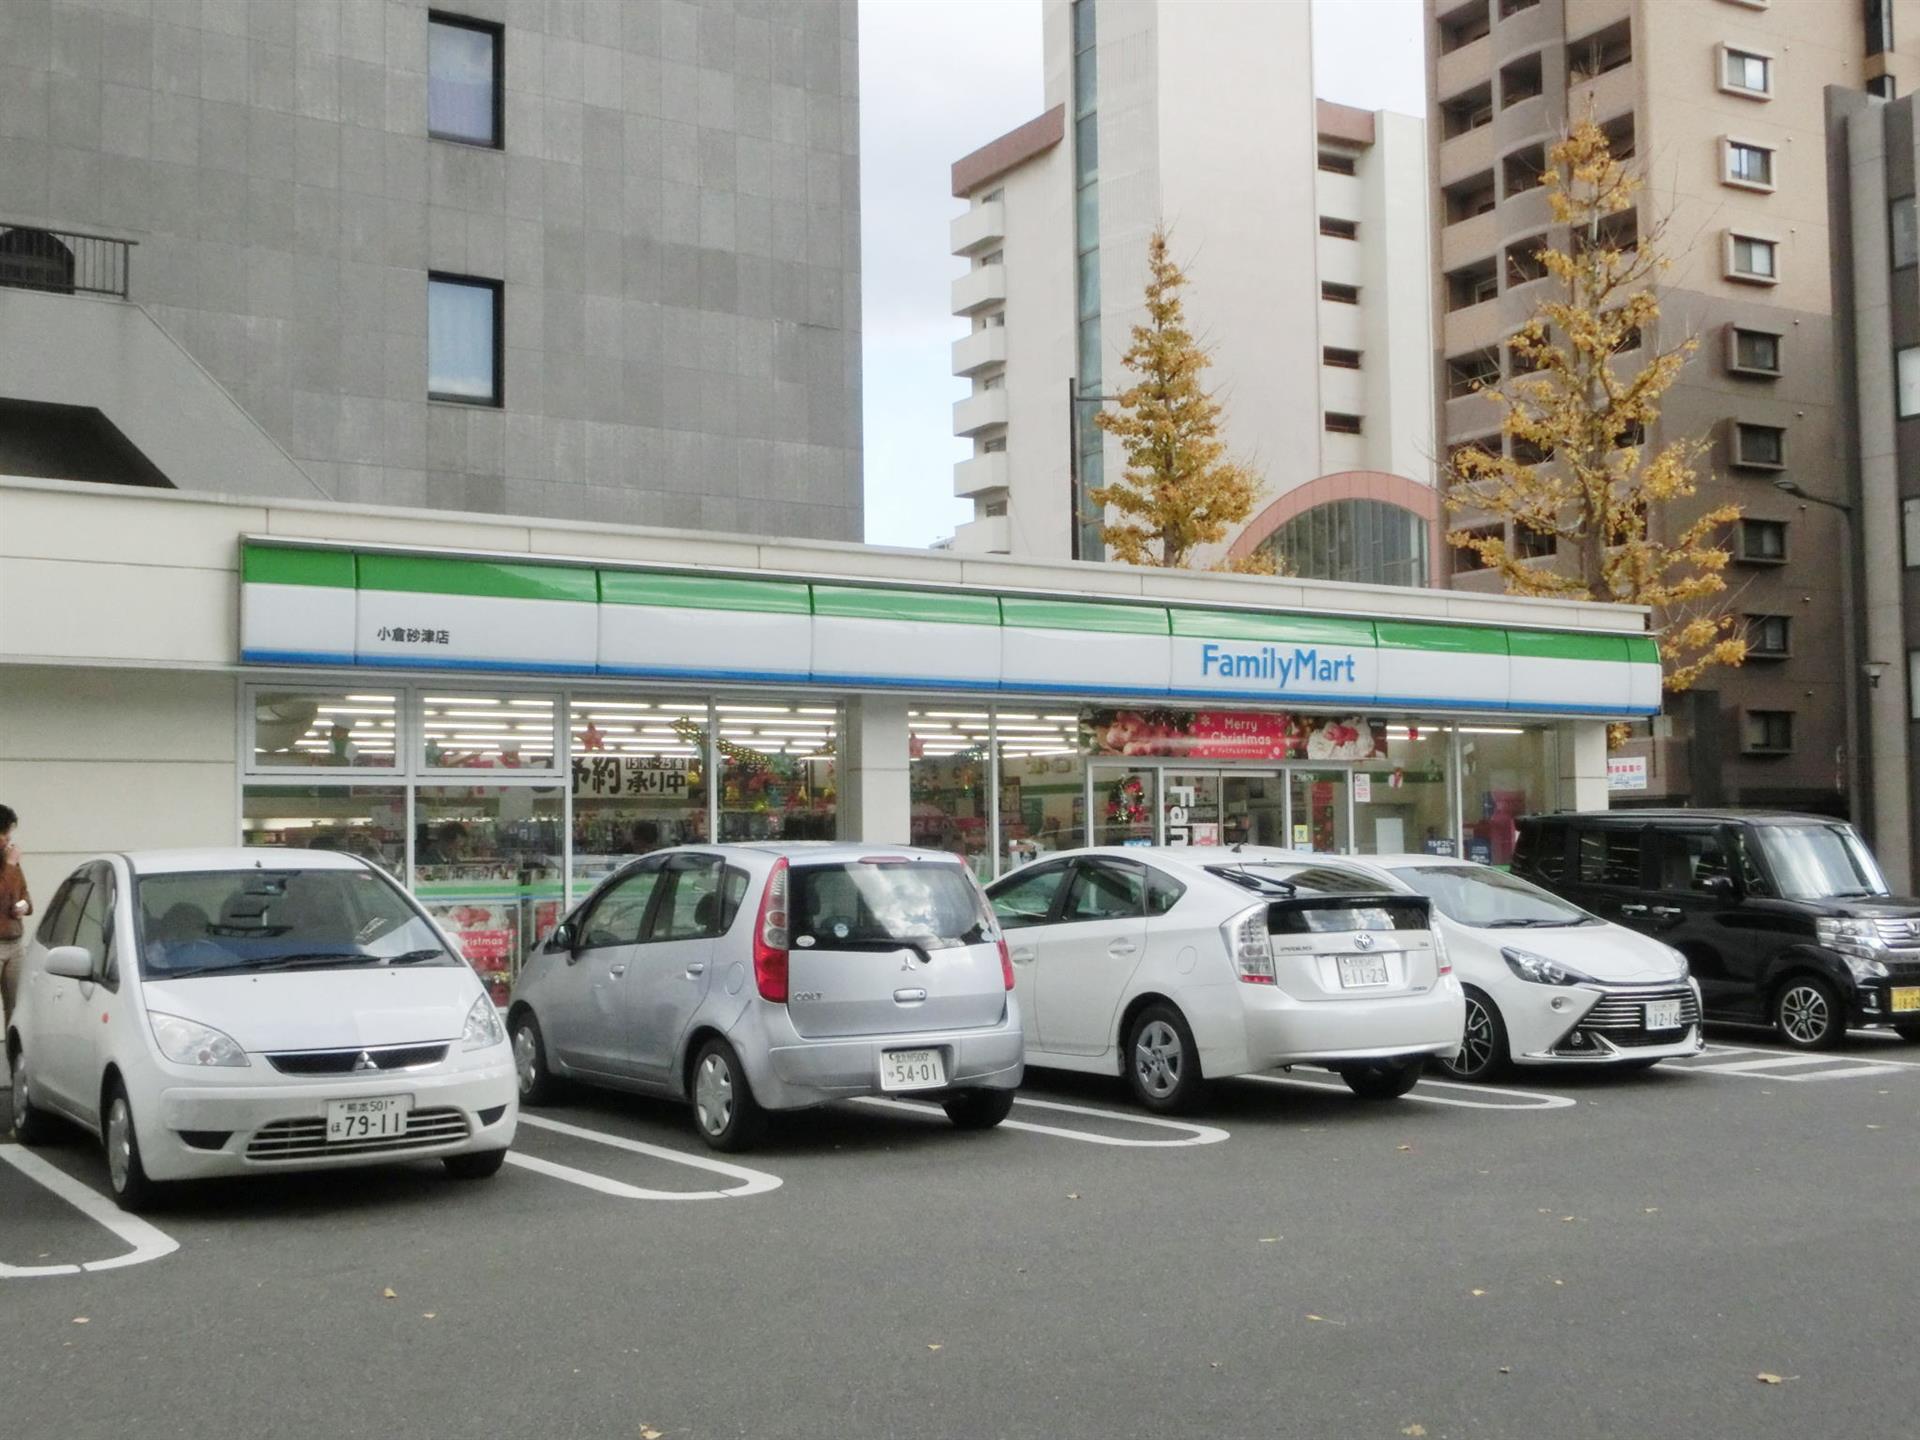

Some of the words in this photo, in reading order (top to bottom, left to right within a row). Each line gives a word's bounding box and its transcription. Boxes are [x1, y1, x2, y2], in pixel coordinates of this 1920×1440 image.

[377, 626, 449, 644] 小倉砂津店
[1202, 644, 1355, 688] FamilyMart
[1225, 718, 1258, 732] Merry
[1211, 731, 1272, 745] Christmas
[626, 771, 686, 793] 承り中
[792, 992, 824, 1002] COLT
[896, 1063, 937, 1082] 54-01
[345, 1113, 399, 1137] 79-11
